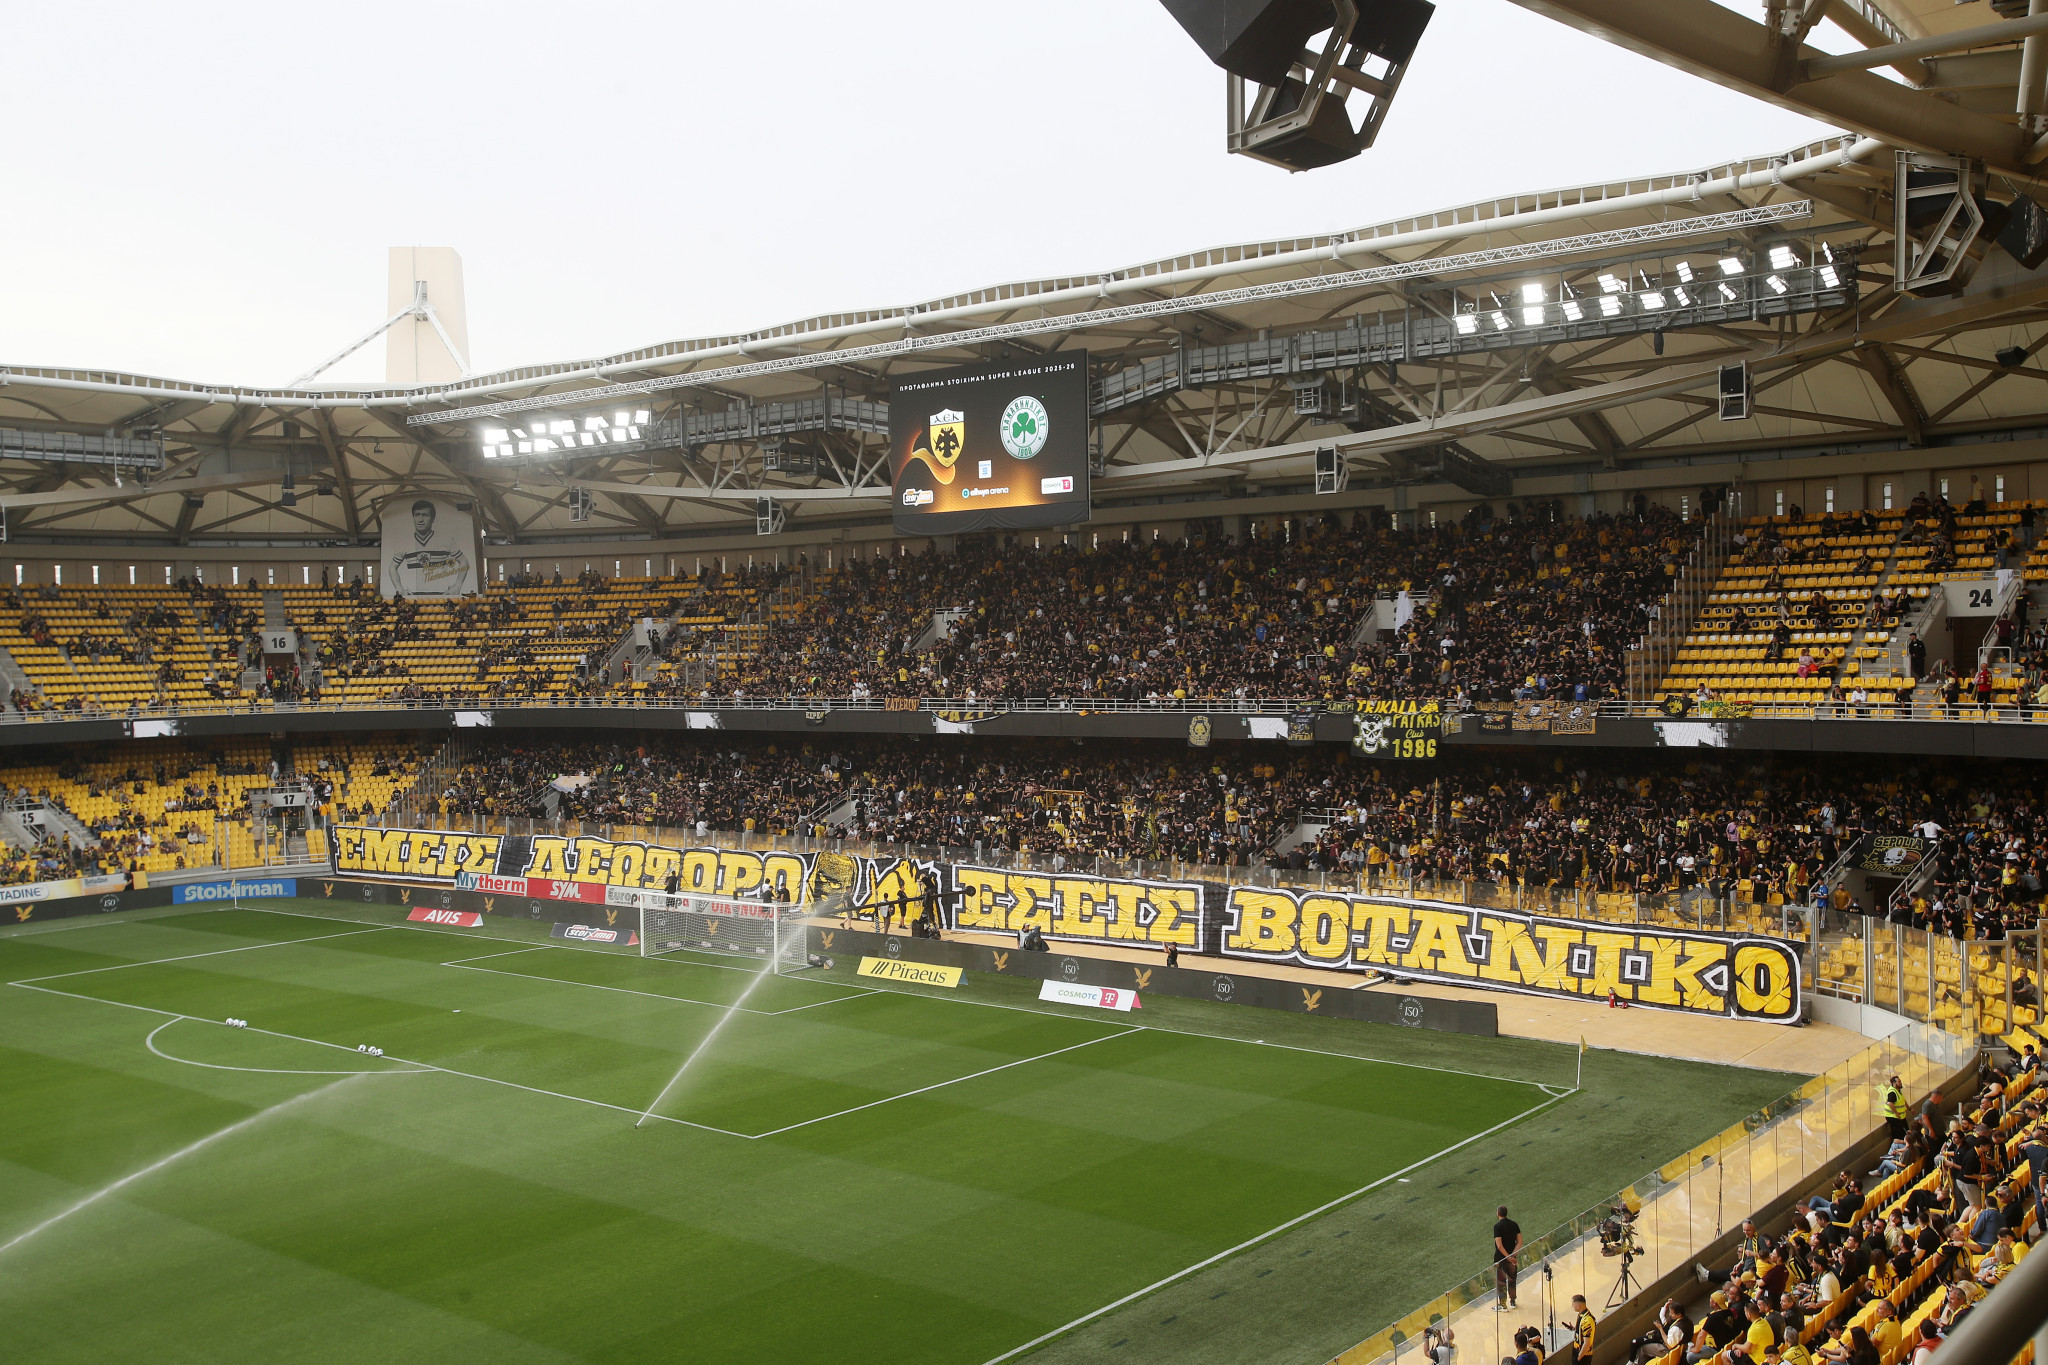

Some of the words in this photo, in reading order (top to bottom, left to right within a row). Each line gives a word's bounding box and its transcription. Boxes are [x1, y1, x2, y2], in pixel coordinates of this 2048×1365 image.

[947, 375, 985, 386] STOIXIMAN
[988, 371, 1011, 381] SUPER
[1013, 368, 1042, 377] LEAGUE
[1044, 363, 1075, 373] 2025-26
[990, 487, 1010, 496] arena
[1969, 588, 1993, 608] 24
[272, 637, 286, 649] 16
[1554, 722, 1591, 732] ΠΑΡΩΝ
[1405, 728, 1425, 740] Club
[1392, 738, 1437, 758] 1986
[283, 795, 295, 805] 17
[22, 812, 35, 824] 15
[1873, 835, 1924, 850] SEPOLIA
[456, 872, 526, 893] Mytherm
[184, 882, 284, 902] Stoiximan
[549, 881, 582, 900] SYM
[423, 909, 463, 924] AVIS
[888, 943, 899, 953] 150
[1228, 890, 1792, 1015] ΒΟΤΑΝΙΚΟ
[889, 962, 947, 984] Piraeus
[1064, 964, 1076, 975] 150
[1217, 983, 1231, 994] 150
[1057, 989, 1098, 1001] COSMOTE
[1404, 1006, 1419, 1018] 150
